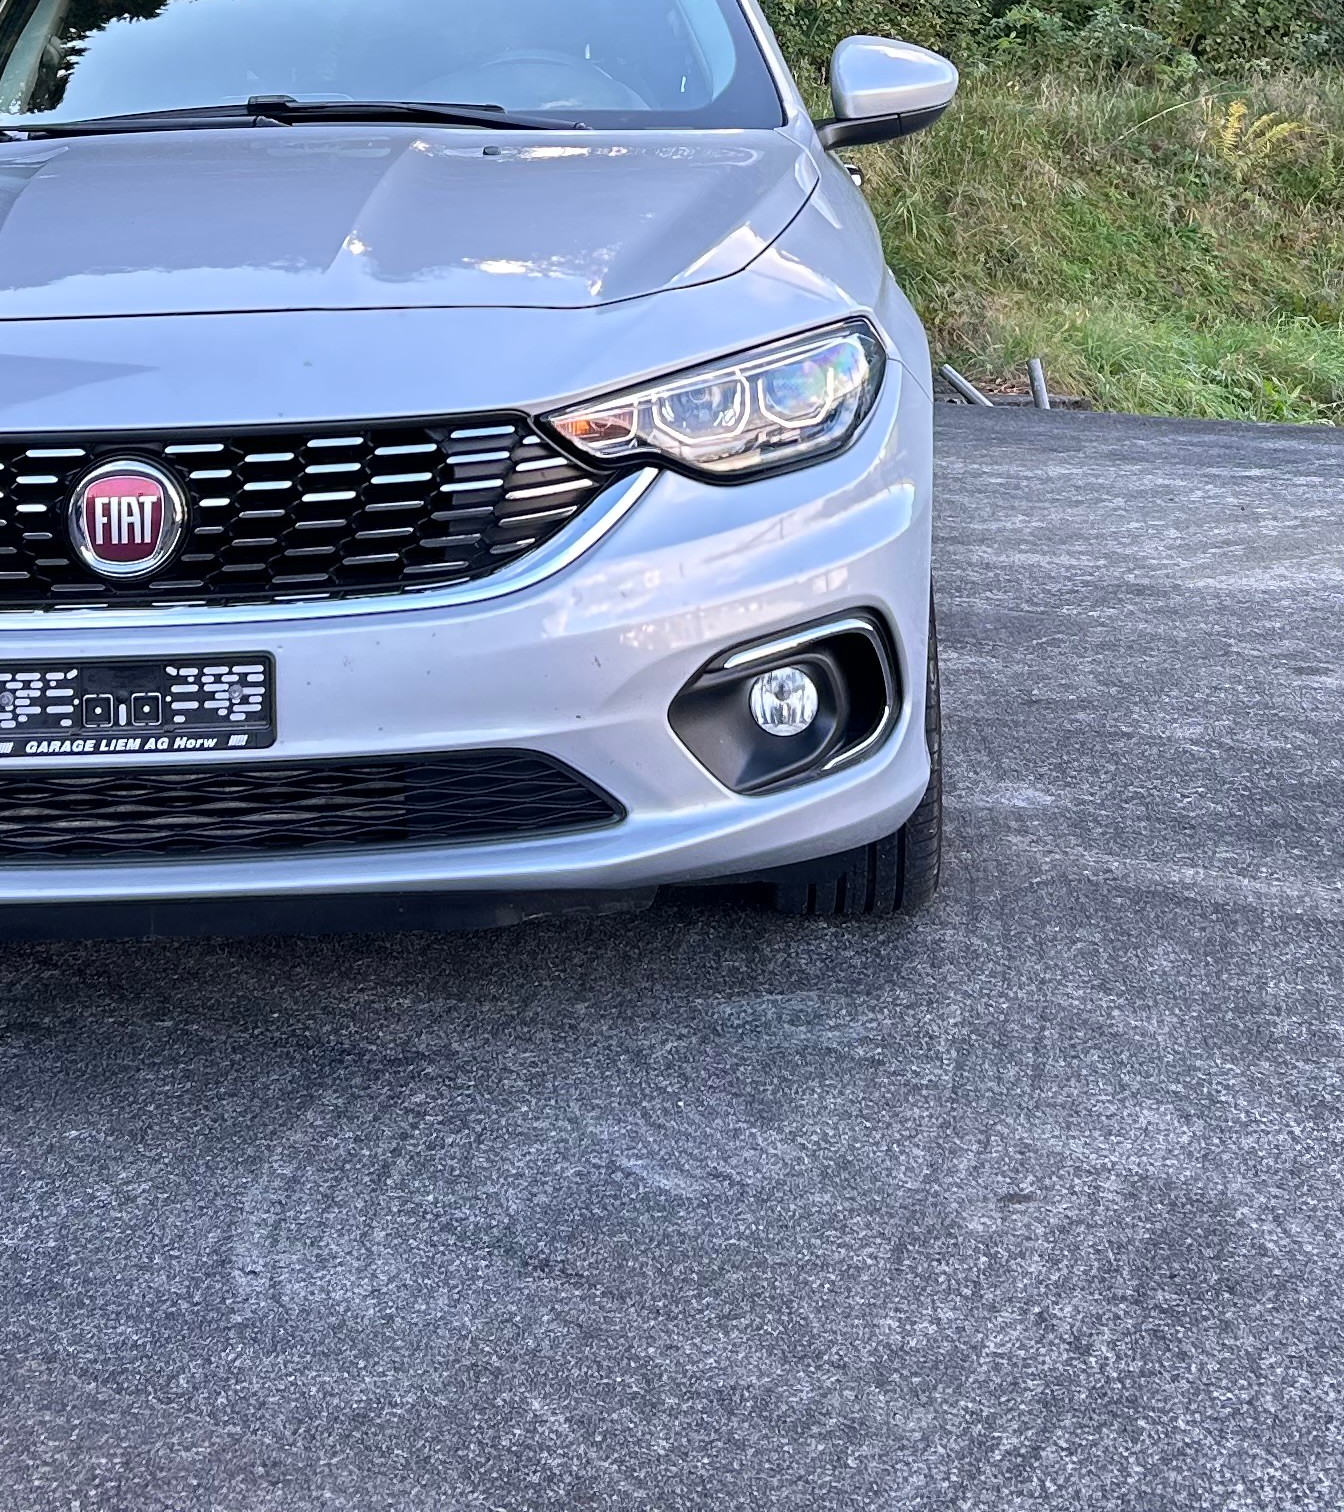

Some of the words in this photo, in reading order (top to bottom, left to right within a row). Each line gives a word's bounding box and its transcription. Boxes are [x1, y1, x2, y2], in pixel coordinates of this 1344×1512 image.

[95, 495, 157, 545] FIAT
[25, 739, 96, 753] GARAGE
[99, 738, 141, 751] LIEM
[144, 738, 169, 750] AG
[173, 737, 217, 749] Horw
